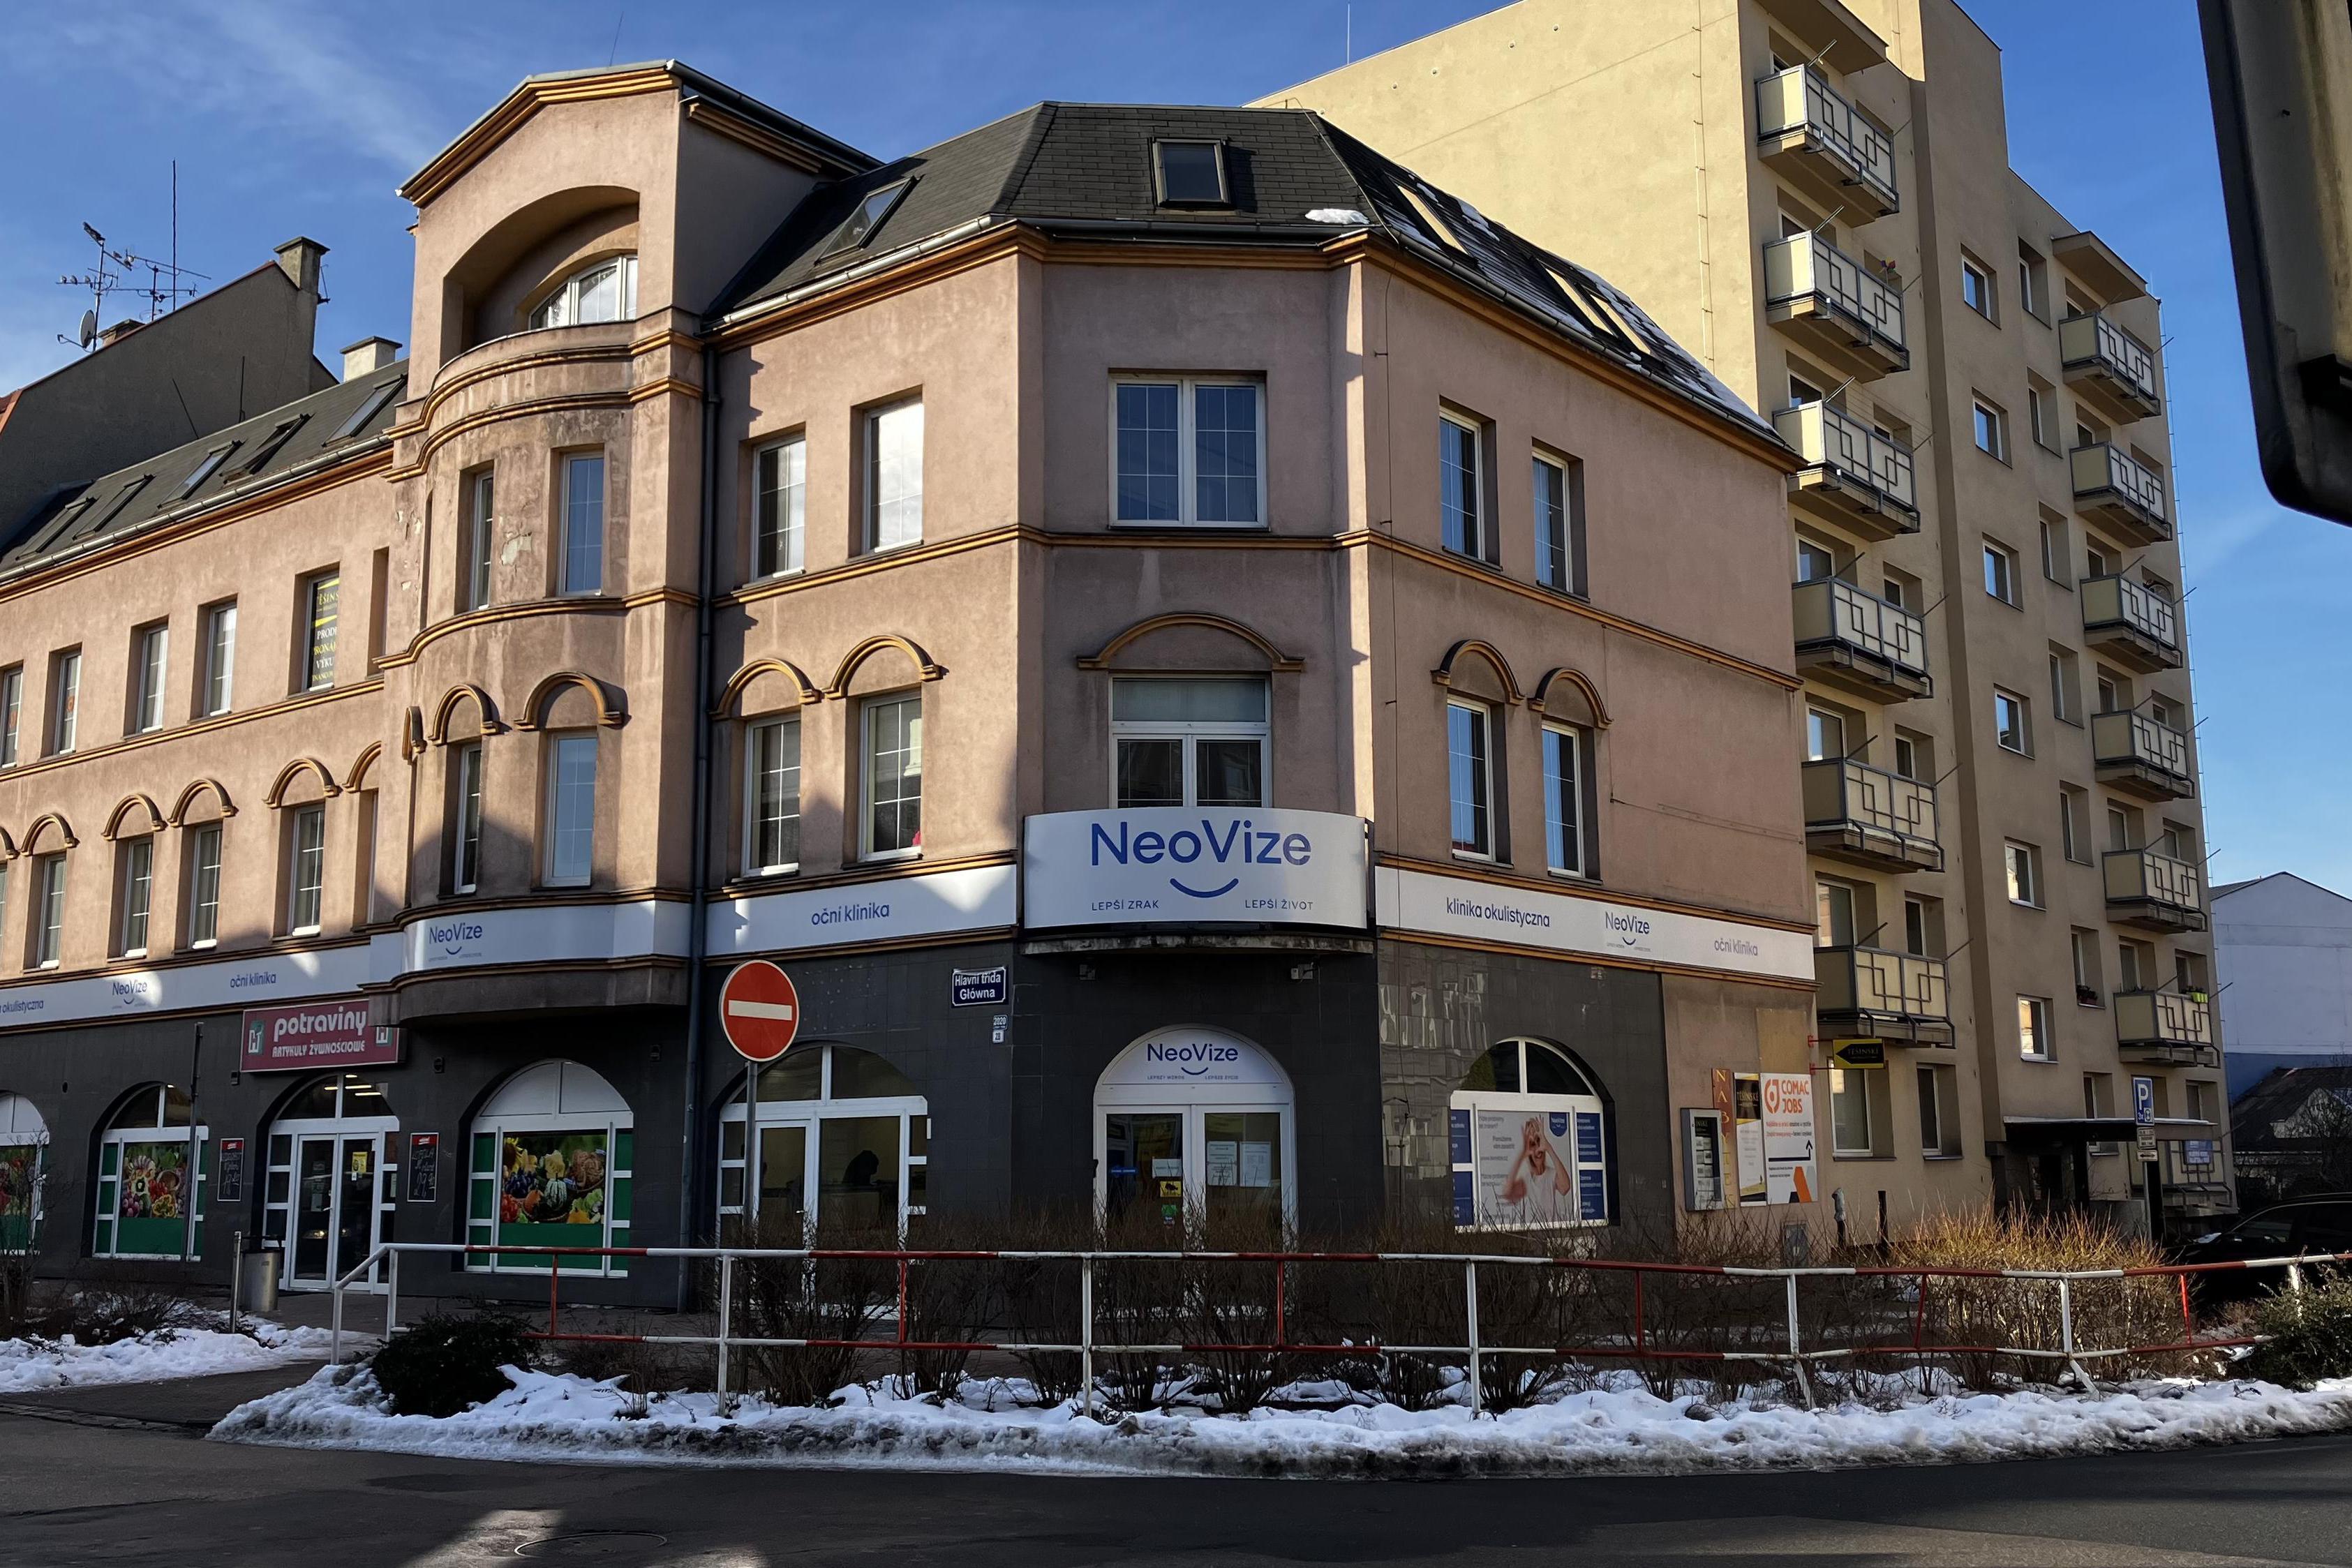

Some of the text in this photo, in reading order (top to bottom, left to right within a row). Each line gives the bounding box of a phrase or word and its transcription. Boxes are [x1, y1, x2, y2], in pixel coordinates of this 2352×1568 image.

[1092, 820, 1311, 865] NeoVize
[844, 902, 890, 922] klinika
[1128, 899, 1159, 909] ZRAK
[1281, 899, 1313, 910] ŽIVOT
[1446, 897, 1550, 927] klinika okulistyczna
[1605, 911, 1650, 934] NeoVize
[429, 923, 482, 944] NeoVize
[1732, 939, 1758, 956] klinika
[249, 971, 276, 985] klinika
[112, 979, 147, 996] NeoVize
[960, 987, 995, 1000] Główna
[3, 1000, 44, 1014] okulistyczna
[274, 1006, 366, 1042] potraviny
[1147, 1043, 1238, 1061] NeoVize
[1782, 1080, 1810, 1095] COMAC
[2138, 1084, 2149, 1110] P
[1782, 1098, 1803, 1114] JOBS
